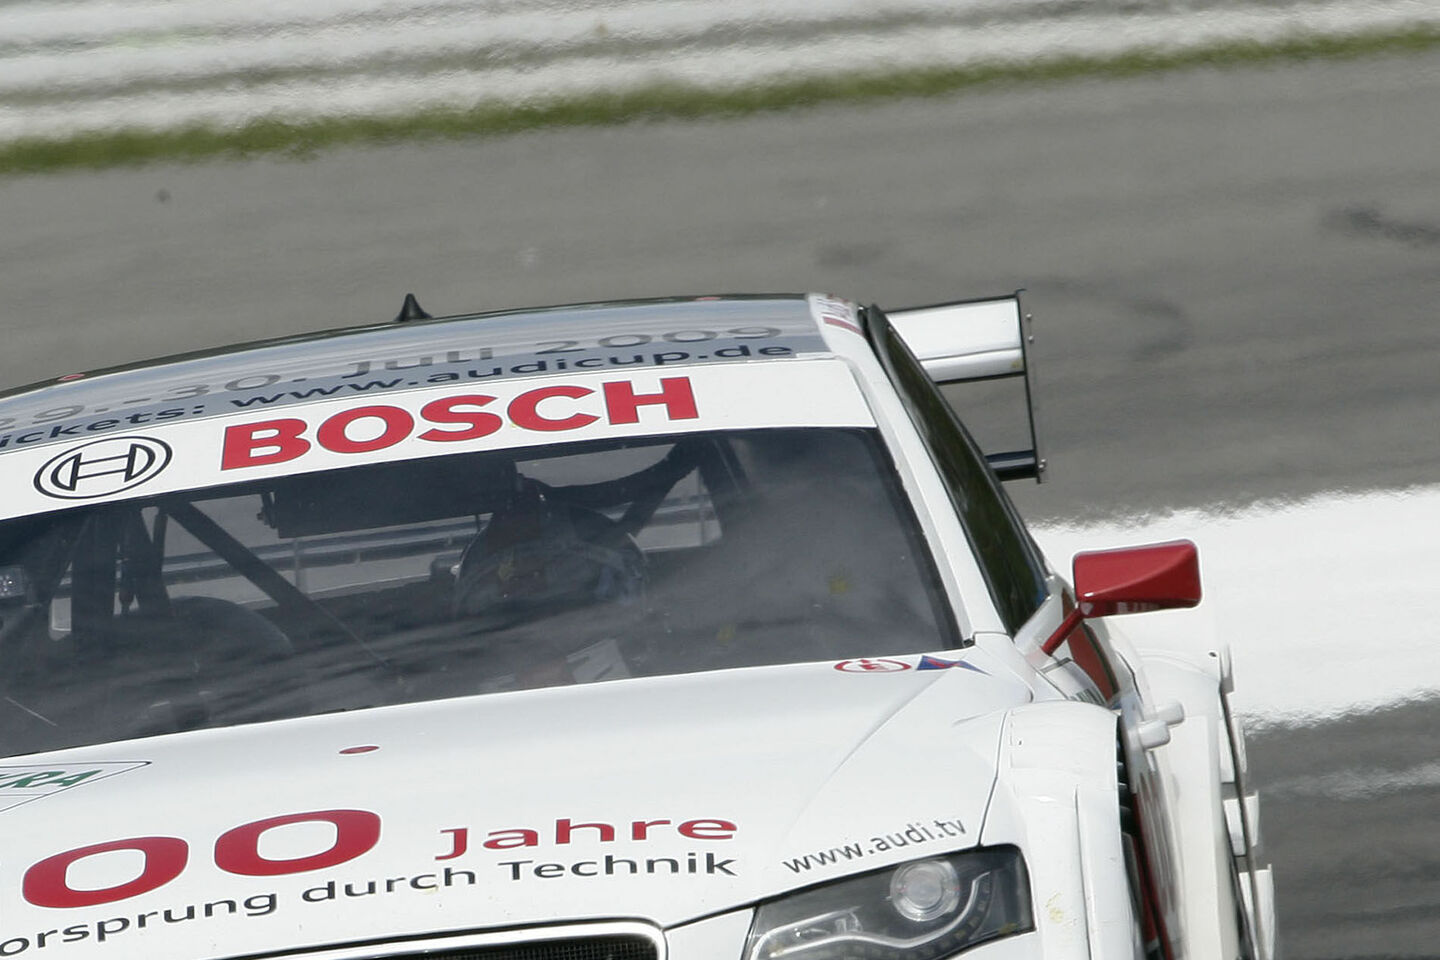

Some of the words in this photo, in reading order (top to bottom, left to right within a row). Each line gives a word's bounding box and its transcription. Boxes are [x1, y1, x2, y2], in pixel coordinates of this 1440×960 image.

[535, 326, 783, 355] 2009
[230, 344, 793, 408] www.audicup.de
[220, 376, 700, 472] BOSCH
[434, 817, 739, 861] Jahre
[781, 817, 969, 875] www.audi.tv
[300, 867, 477, 902] durch
[497, 851, 739, 882] Technik
